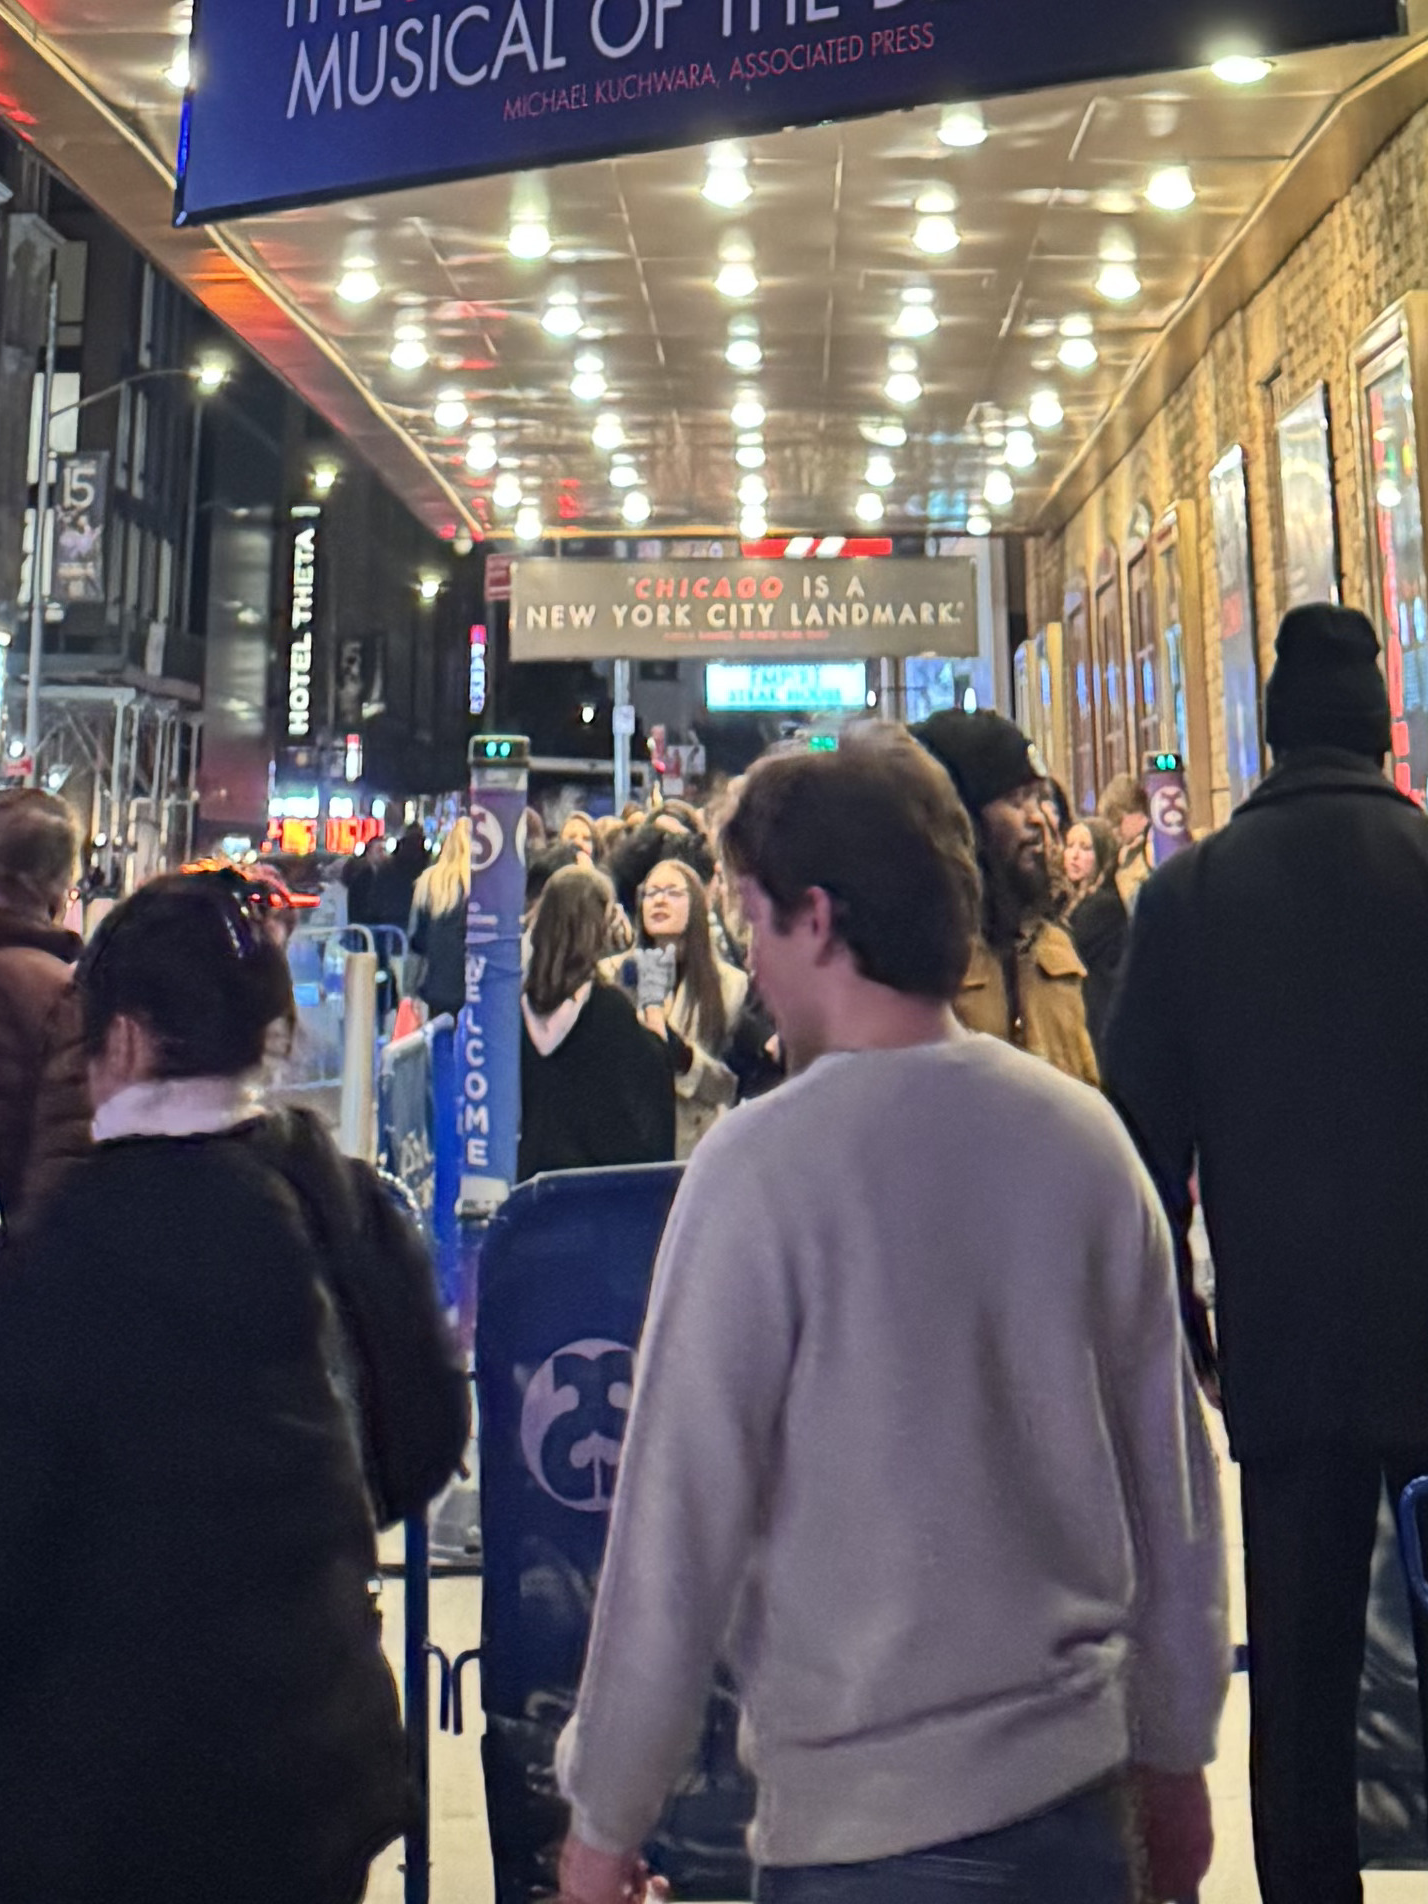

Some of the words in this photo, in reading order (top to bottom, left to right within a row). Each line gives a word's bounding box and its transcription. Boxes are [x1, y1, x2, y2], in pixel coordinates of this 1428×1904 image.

[502, 82, 590, 121] MICHAEL
[593, 61, 721, 106] KUCHWARA,
[728, 34, 866, 84] ASSOCIATED
[870, 21, 936, 56] PRESS
[62, 467, 98, 511] 15
[291, 527, 317, 630] THETA
[802, 575, 828, 598] IS
[844, 575, 866, 598] A
[526, 604, 597, 630] NEW
[611, 603, 692, 628] YORK
[706, 603, 775, 628] CITY
[288, 631, 313, 736] HOTEL
